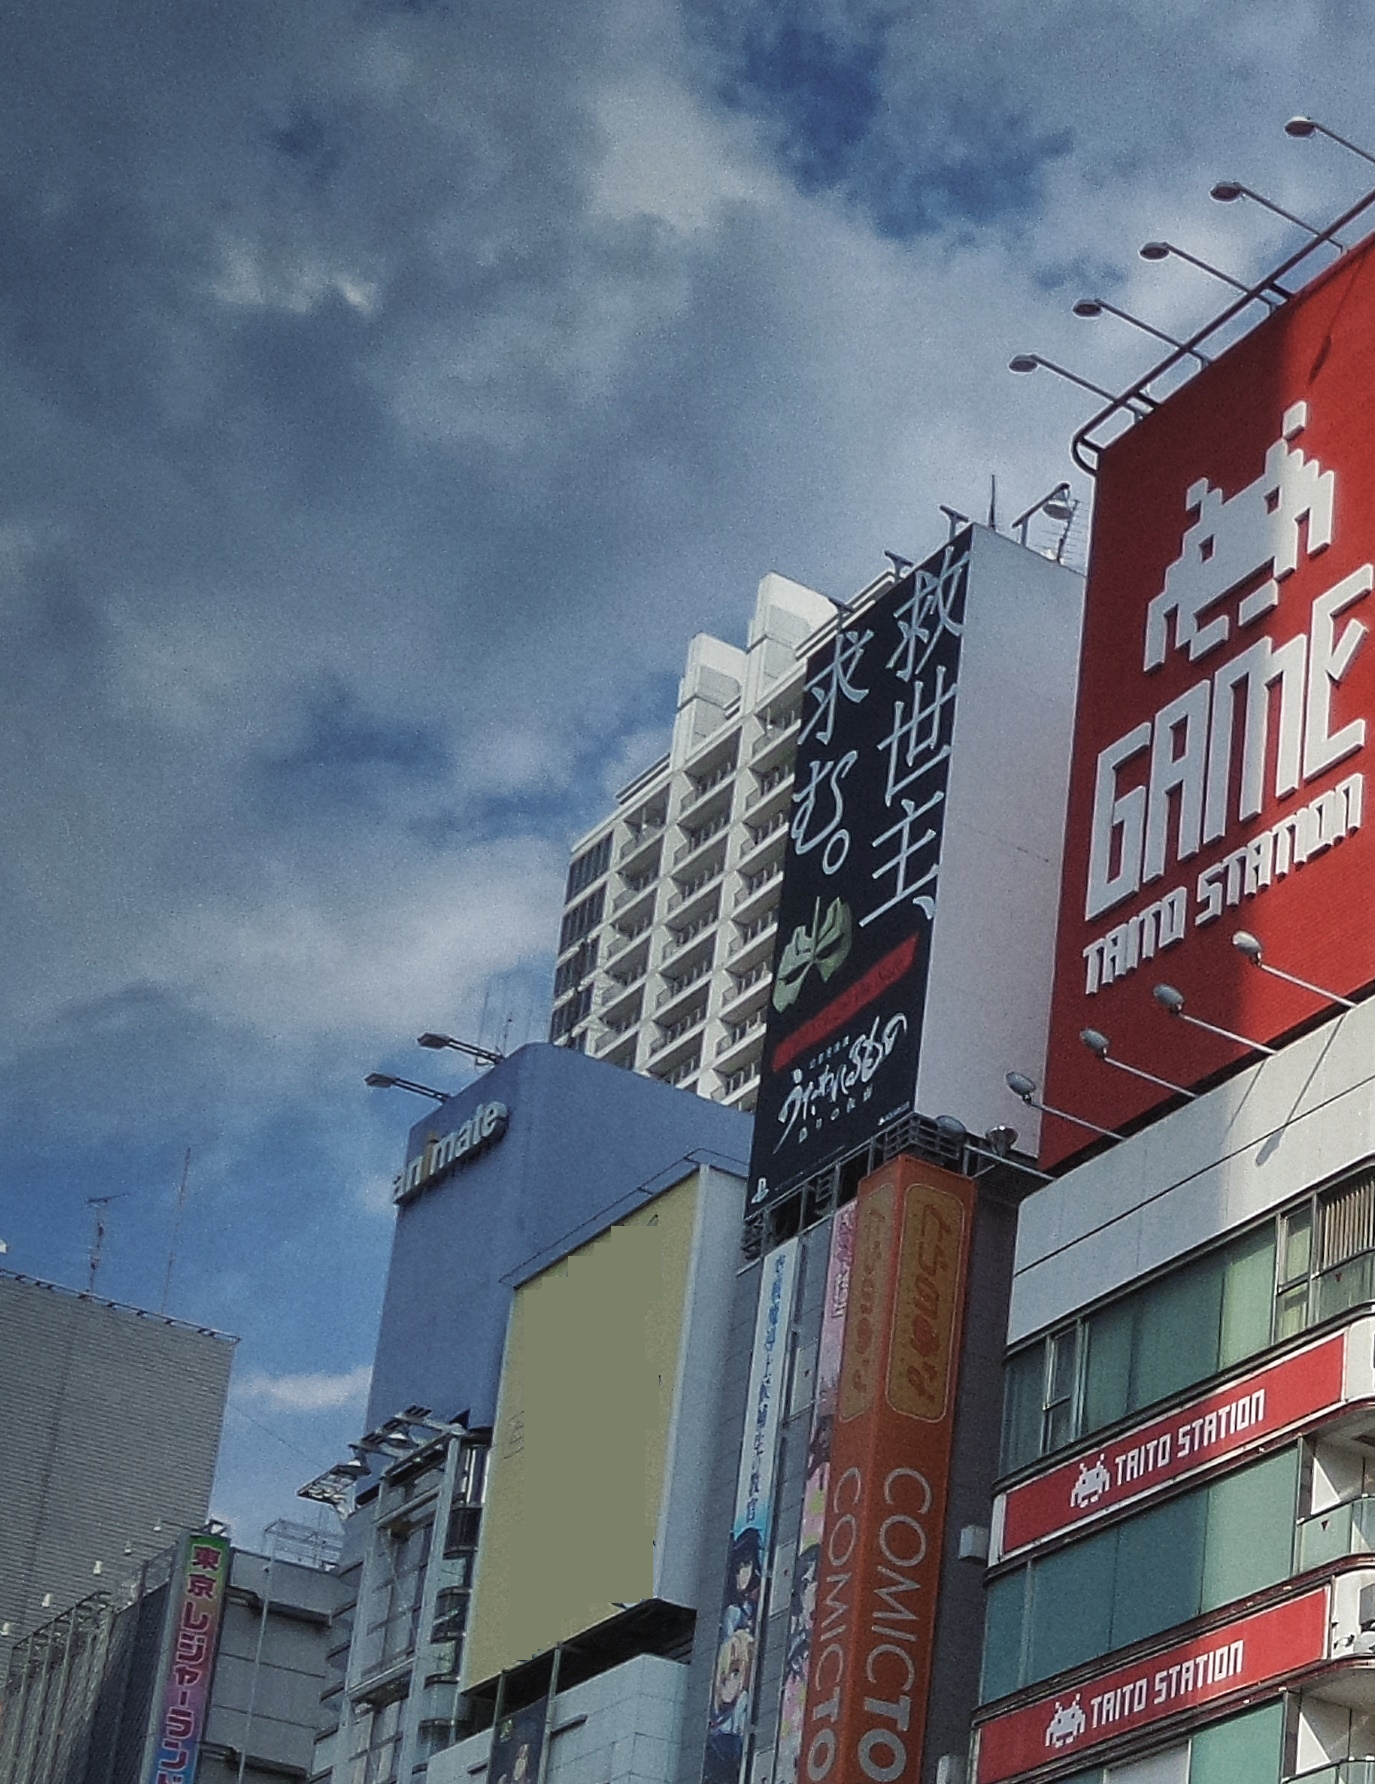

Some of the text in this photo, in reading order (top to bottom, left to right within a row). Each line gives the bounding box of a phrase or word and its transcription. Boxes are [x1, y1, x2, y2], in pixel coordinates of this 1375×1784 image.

[791, 628, 876, 876] 求む。
[858, 545, 972, 928] 救世主、
[1083, 562, 1374, 922] GAME
[1083, 772, 1364, 996] TAITO STATION
[391, 1100, 510, 1206] animate
[1115, 1387, 1266, 1487] TAITO STATION
[814, 1465, 862, 1690] COMIC
[862, 1465, 932, 1696] COMIC
[1090, 1638, 1245, 1731] TAITO STATION
